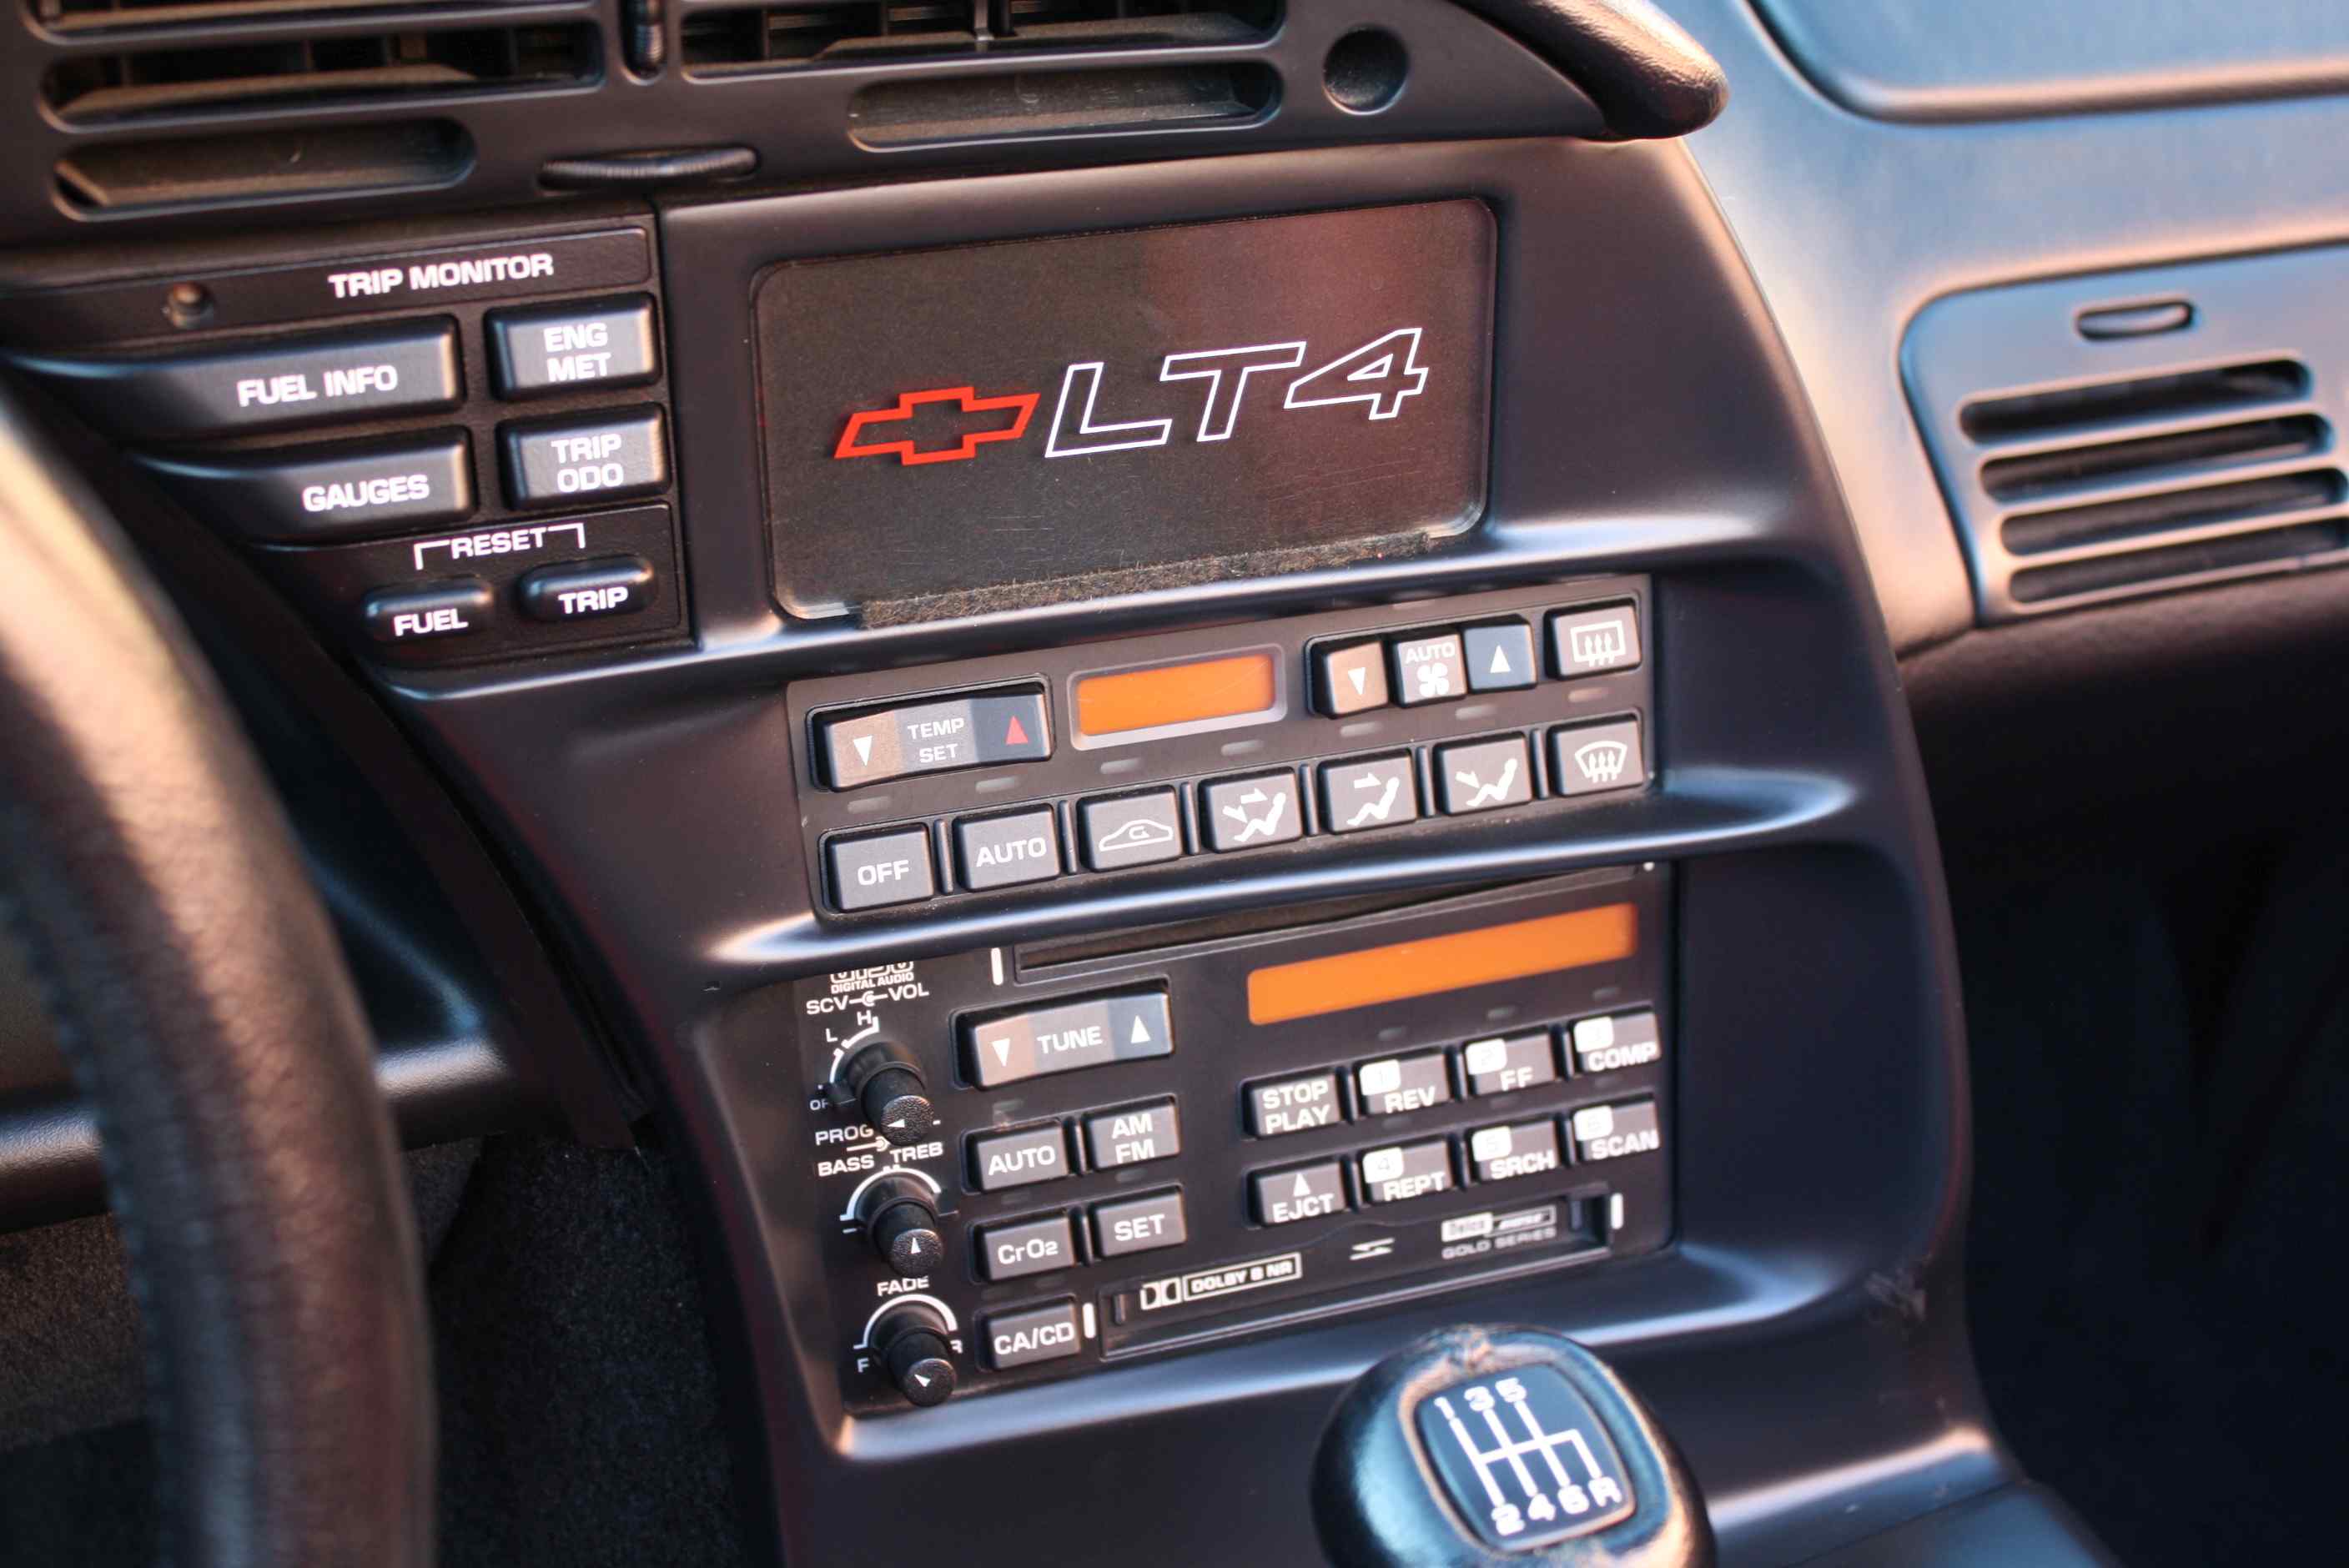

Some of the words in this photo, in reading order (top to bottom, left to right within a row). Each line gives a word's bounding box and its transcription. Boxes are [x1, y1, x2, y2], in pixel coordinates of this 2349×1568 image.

[328, 269, 403, 299] TRIP
[410, 253, 555, 290] MONITOR
[543, 323, 609, 353] ENG
[546, 353, 611, 383] MET
[237, 374, 317, 407] FUEL
[323, 365, 399, 397] INFO
[1045, 328, 1429, 459] LT4
[551, 434, 623, 464] TRIP
[556, 463, 625, 494] ODO
[302, 475, 430, 513] GAUGES
[450, 526, 546, 560] RESET
[557, 586, 629, 616] TRIP
[393, 608, 469, 637] FUEL
[1405, 641, 1456, 665] AUTO
[907, 717, 965, 741] TEMP
[918, 743, 958, 763] SET
[975, 837, 1048, 867] AUTO
[857, 859, 910, 887] OFF
[805, 994, 849, 1015] SCV
[888, 982, 930, 1002] VOL
[831, 978, 876, 995] DIGITAL
[877, 972, 915, 988] AUDIO
[825, 1028, 838, 1043] L
[857, 1009, 873, 1026] H
[1037, 1026, 1104, 1055] TUNE
[1587, 1041, 1658, 1073] COMP
[1500, 1066, 1534, 1092] FF
[809, 1098, 828, 1111] OF
[1262, 1080, 1329, 1109] STOP
[1384, 1086, 1436, 1114] REV
[815, 1123, 875, 1146] PROG
[1110, 1113, 1154, 1141] AM
[1265, 1104, 1331, 1135] PLAY
[1115, 1138, 1156, 1165] FM
[1590, 1128, 1660, 1160] SCAN
[817, 1153, 875, 1178] BASS
[889, 1141, 944, 1163] TREB
[988, 1145, 1056, 1176] AUTO
[1489, 1149, 1557, 1180] SRCH
[1382, 1172, 1446, 1202] REPT
[1272, 1193, 1335, 1224] EJCT
[1114, 1214, 1166, 1241] SET
[877, 1275, 930, 1297] FADE
[1190, 1269, 1248, 1294] DOLBY
[993, 1321, 1076, 1355] CA/CD
[1433, 1395, 1456, 1420] 1
[1463, 1385, 1495, 1412] 3
[1495, 1377, 1527, 1404] 5
[1490, 1504, 1526, 1536] 2
[1527, 1492, 1556, 1522] 4
[1587, 1475, 1622, 1508] R
